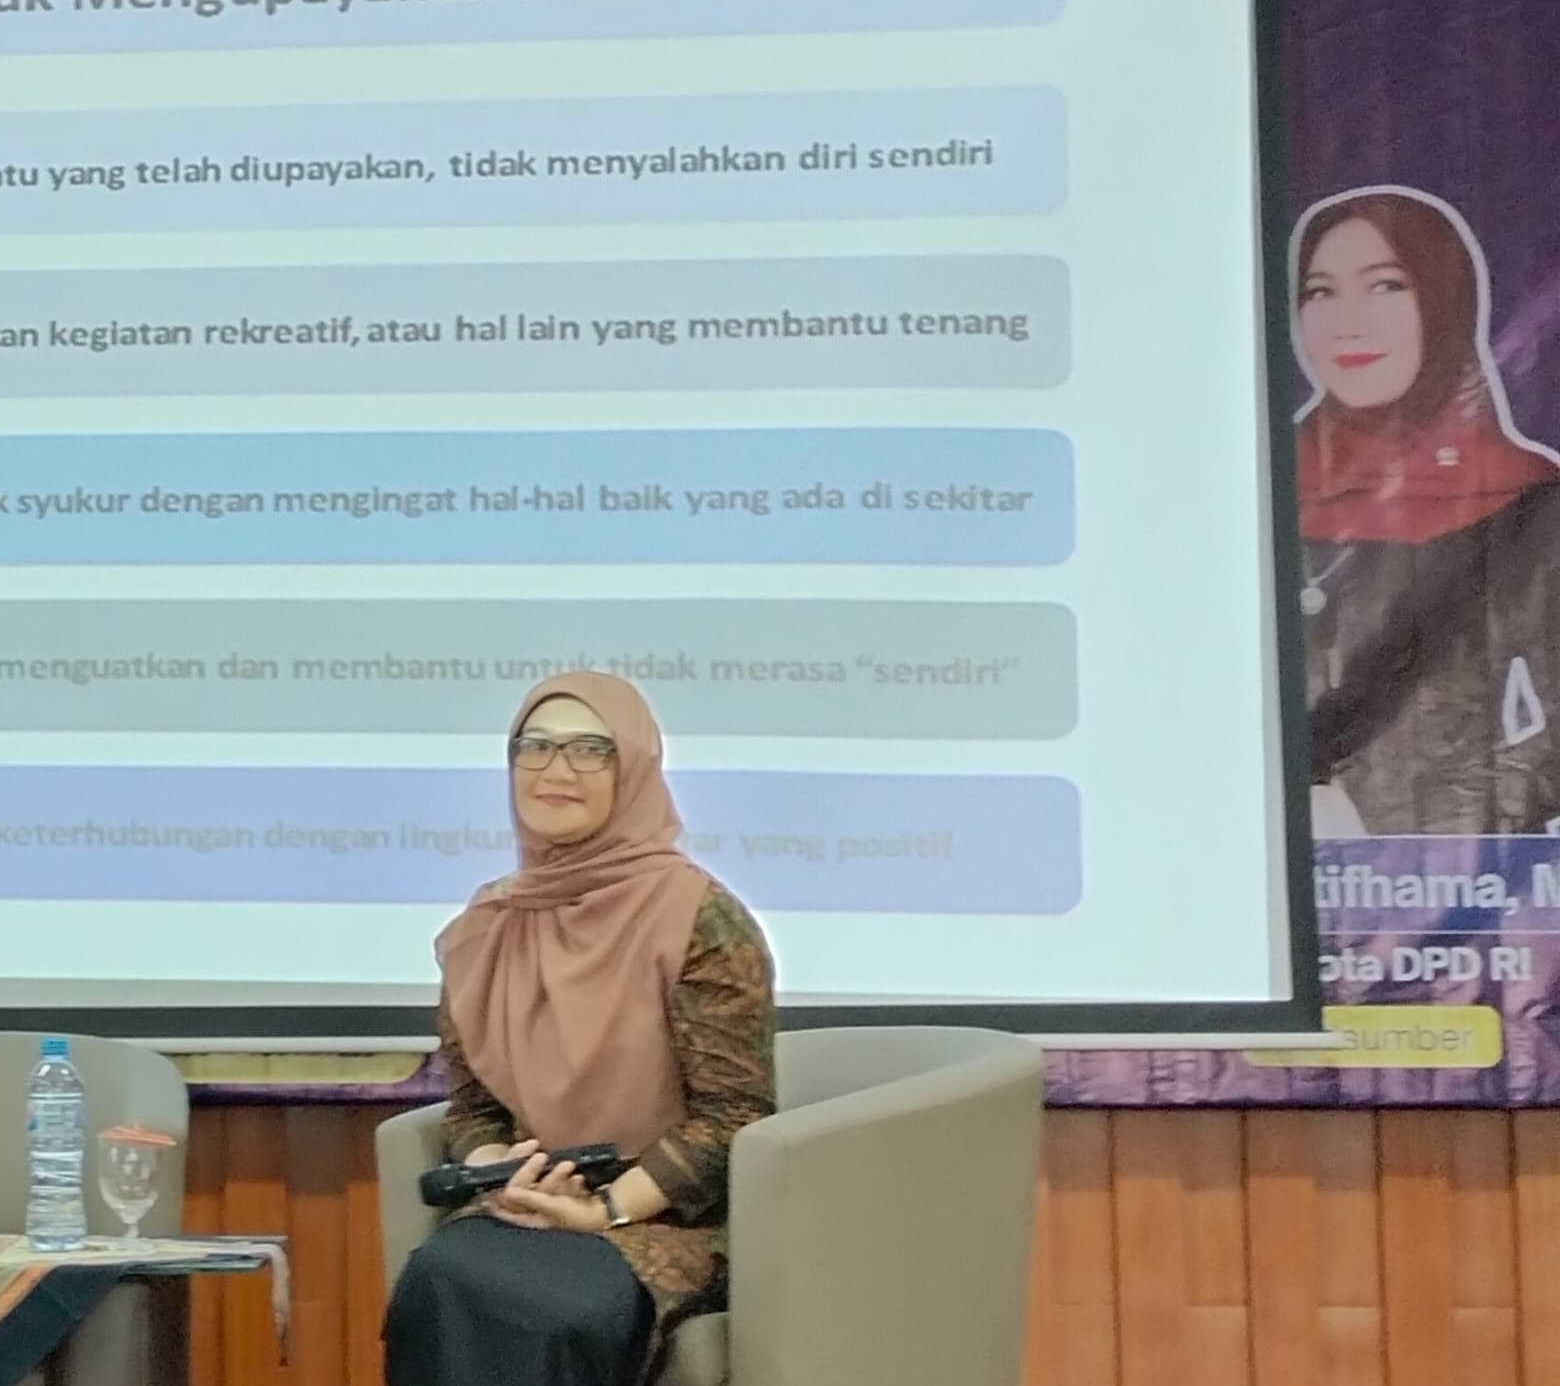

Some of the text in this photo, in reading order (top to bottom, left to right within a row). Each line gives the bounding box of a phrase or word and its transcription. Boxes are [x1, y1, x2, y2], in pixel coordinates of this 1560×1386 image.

[46, 163, 126, 193] yang
[133, 155, 222, 185] telah
[228, 152, 435, 188] diupayakan,
[447, 148, 537, 178] tidak
[546, 144, 786, 181] menyalahkan
[797, 141, 858, 171] diri
[867, 138, 993, 170] sendiri
[48, 319, 192, 354] kegiatan
[203, 315, 360, 349] rekreatif,
[366, 317, 441, 344] atau
[454, 313, 507, 342] hal
[516, 312, 580, 341] lain
[590, 316, 677, 347] yang
[687, 308, 888, 339] membantu
[897, 310, 1029, 343] tenang
[16, 484, 132, 521] syukur
[138, 484, 265, 521] dengan
[272, 484, 457, 519] mengingat
[468, 482, 585, 513] hal-hal
[597, 482, 674, 512] baik
[683, 487, 771, 519] yang
[781, 479, 845, 511] ada
[859, 479, 893, 510] di
[902, 482, 1033, 513] sekitar
[216, 650, 280, 681] dan
[290, 651, 486, 682] membantu
[607, 651, 698, 683] tidak
[708, 657, 848, 684] merasa
[262, 819, 391, 856] dengan
[737, 831, 827, 864] yang
[835, 828, 956, 863] positif
[1391, 946, 1484, 982] DPD
[1489, 947, 1533, 982] RI
